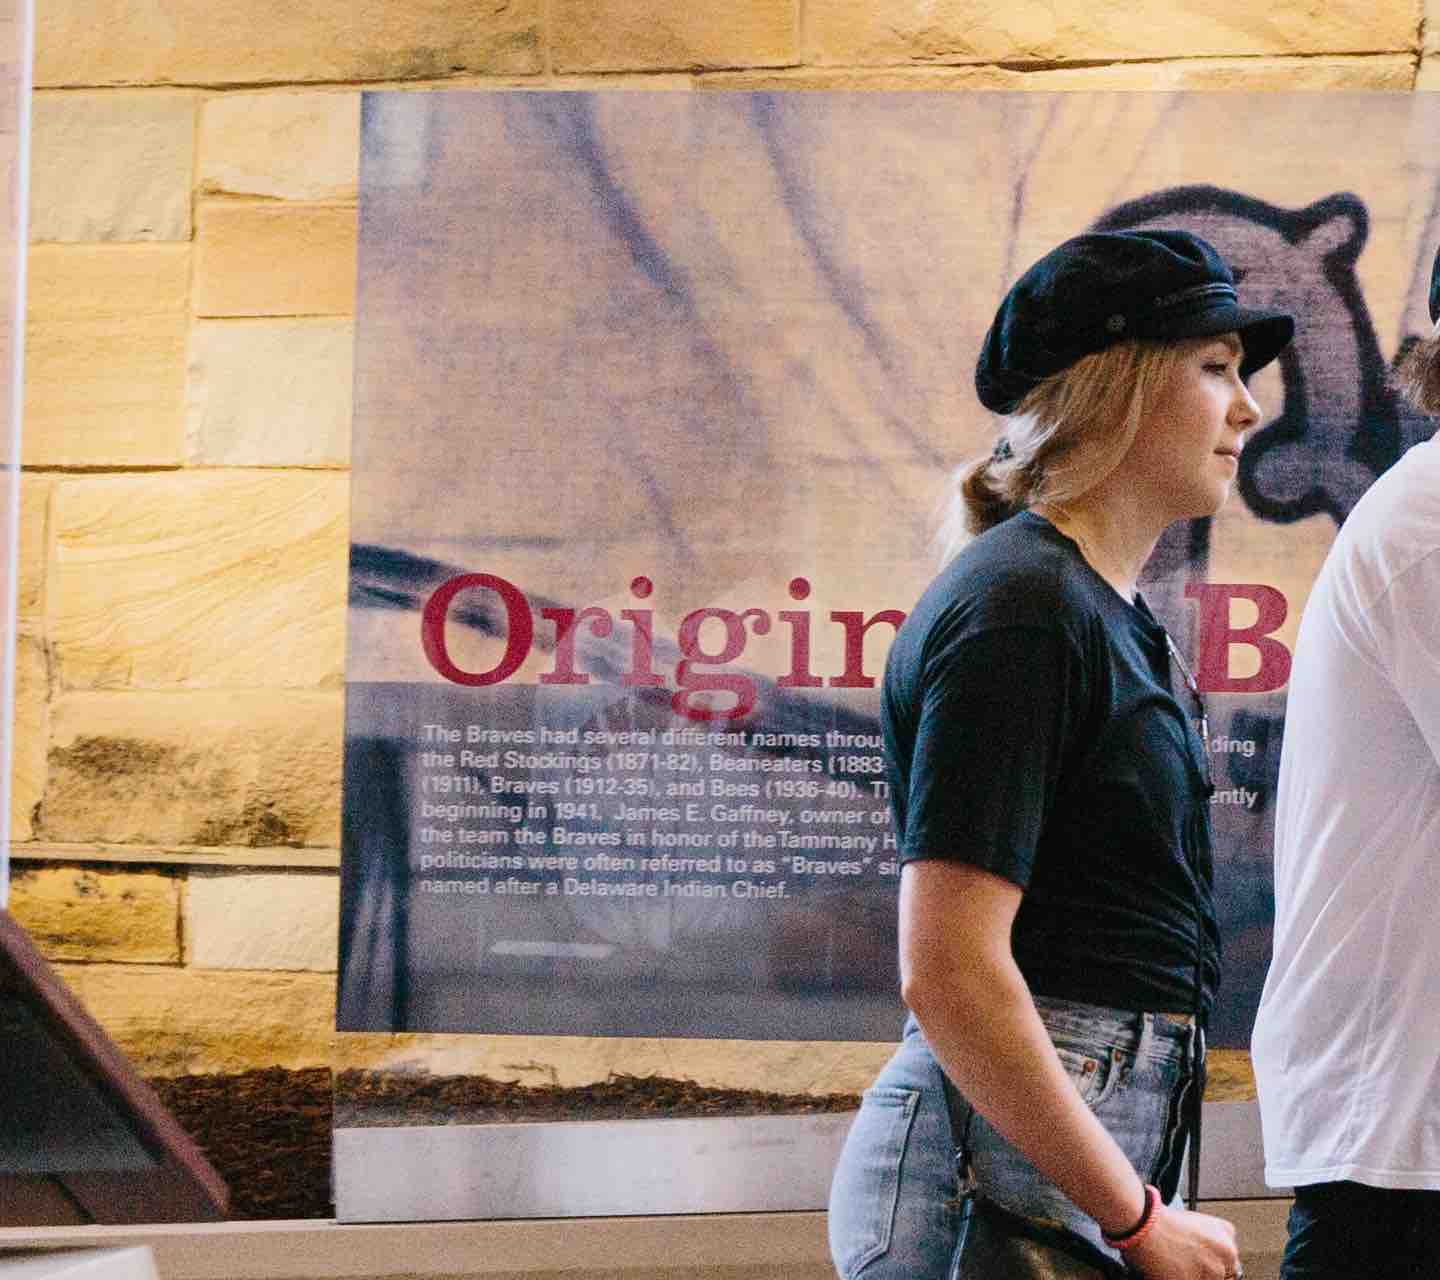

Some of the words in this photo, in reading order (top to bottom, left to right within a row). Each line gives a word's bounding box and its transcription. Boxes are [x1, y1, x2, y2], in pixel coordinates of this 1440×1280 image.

[423, 725, 460, 743] The
[467, 726, 535, 744] Braves
[540, 727, 578, 744] had
[583, 728, 656, 745] several
[662, 728, 747, 747] different
[752, 732, 821, 747] names
[420, 751, 455, 768] the
[461, 751, 500, 769] Red
[503, 751, 601, 773] Stockings
[711, 754, 823, 772] Beaneaters
[490, 776, 560, 795] Braves
[666, 779, 705, 797] and
[711, 779, 760, 797] Bees
[421, 801, 522, 822] beginning
[528, 802, 547, 819] in
[613, 804, 681, 821] James
[686, 805, 706, 822] E.
[711, 805, 793, 827] Gaffney,
[799, 810, 865, 824] owner
[870, 806, 890, 824] of
[420, 828, 453, 844] the
[459, 828, 509, 844] team
[513, 827, 547, 845] the
[551, 827, 621, 846] Braves
[626, 828, 645, 846] in
[651, 829, 712, 848] honor
[717, 829, 737, 848] of
[743, 830, 777, 848] the
[779, 830, 878, 853] Tammany
[419, 851, 527, 872] politicians
[528, 856, 578, 870] were
[583, 852, 635, 871] often
[639, 854, 722, 872] referred
[726, 857, 748, 873] to
[751, 859, 776, 873] as
[420, 877, 489, 895] named
[493, 877, 541, 895] after
[545, 881, 559, 895] a
[563, 878, 659, 897] Delaware
[663, 880, 726, 897] Indian
[731, 880, 791, 899] Chief.
